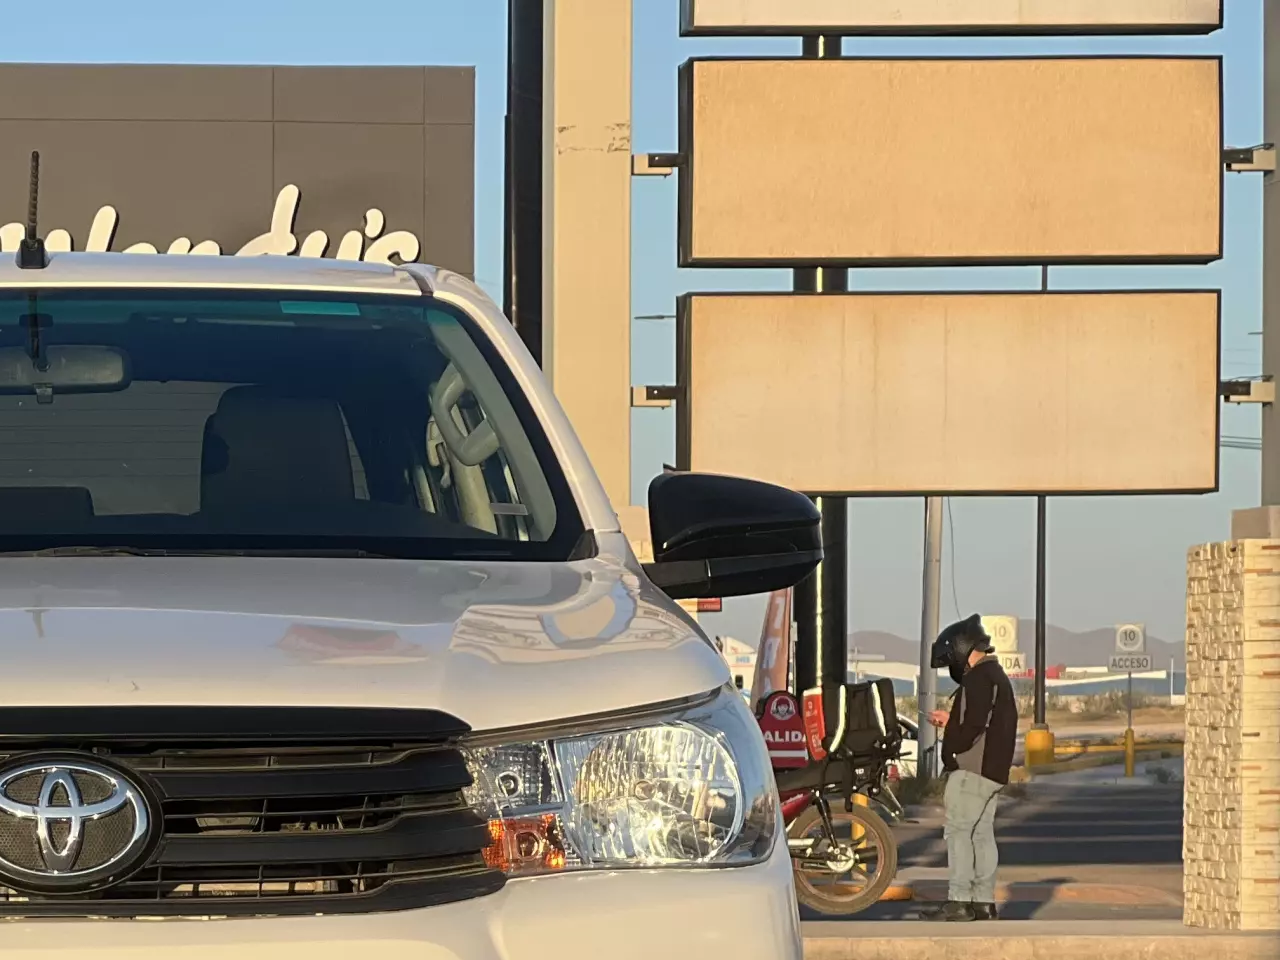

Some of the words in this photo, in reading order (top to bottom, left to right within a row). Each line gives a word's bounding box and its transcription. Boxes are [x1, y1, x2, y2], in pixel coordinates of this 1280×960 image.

[993, 625, 1007, 638] 10
[1123, 630, 1136, 641] 10
[1111, 657, 1149, 669] ACCESO
[763, 730, 807, 743] ALID
